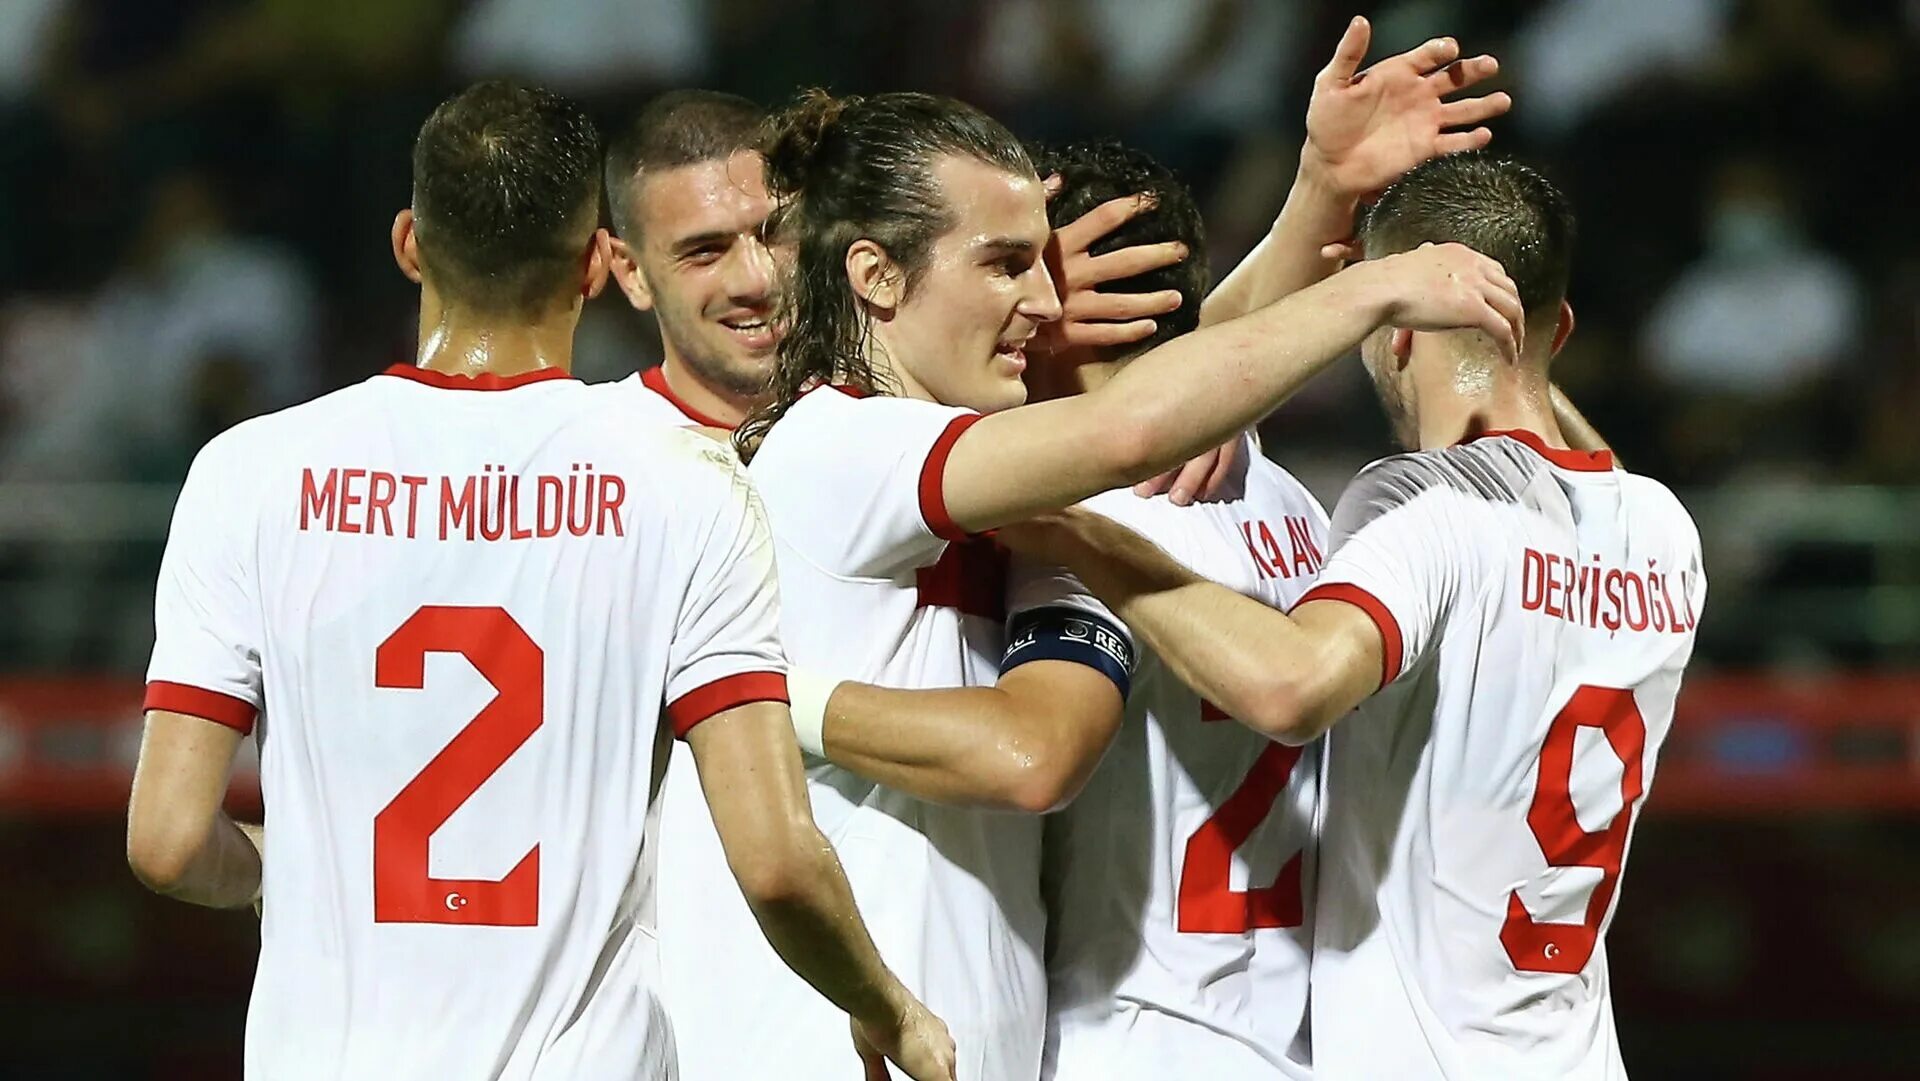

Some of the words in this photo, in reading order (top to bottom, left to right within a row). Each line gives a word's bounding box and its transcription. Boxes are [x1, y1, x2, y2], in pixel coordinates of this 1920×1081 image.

[299, 467, 428, 538] MERT
[438, 463, 626, 542] MÜLDÜR
[373, 604, 544, 926] 2
[1499, 684, 1647, 974] 9
